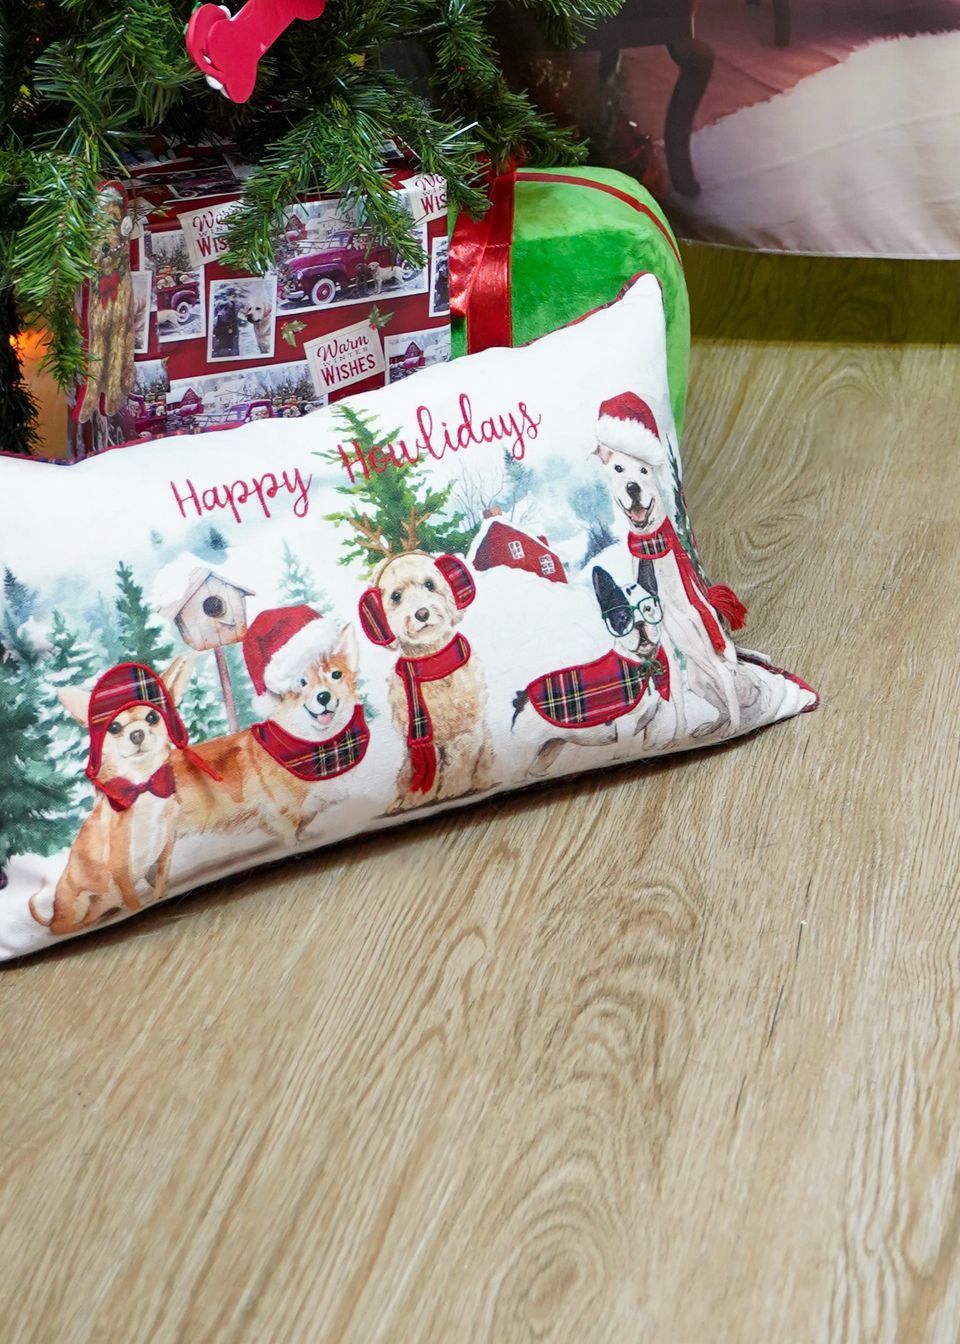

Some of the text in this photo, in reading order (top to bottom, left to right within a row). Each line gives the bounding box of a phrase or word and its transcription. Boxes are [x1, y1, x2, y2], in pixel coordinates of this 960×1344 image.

[196, 236, 228, 257] WIS
[317, 335, 369, 362] Warm
[320, 353, 376, 386] WISHES
[170, 392, 542, 524] Happy Howlidays
